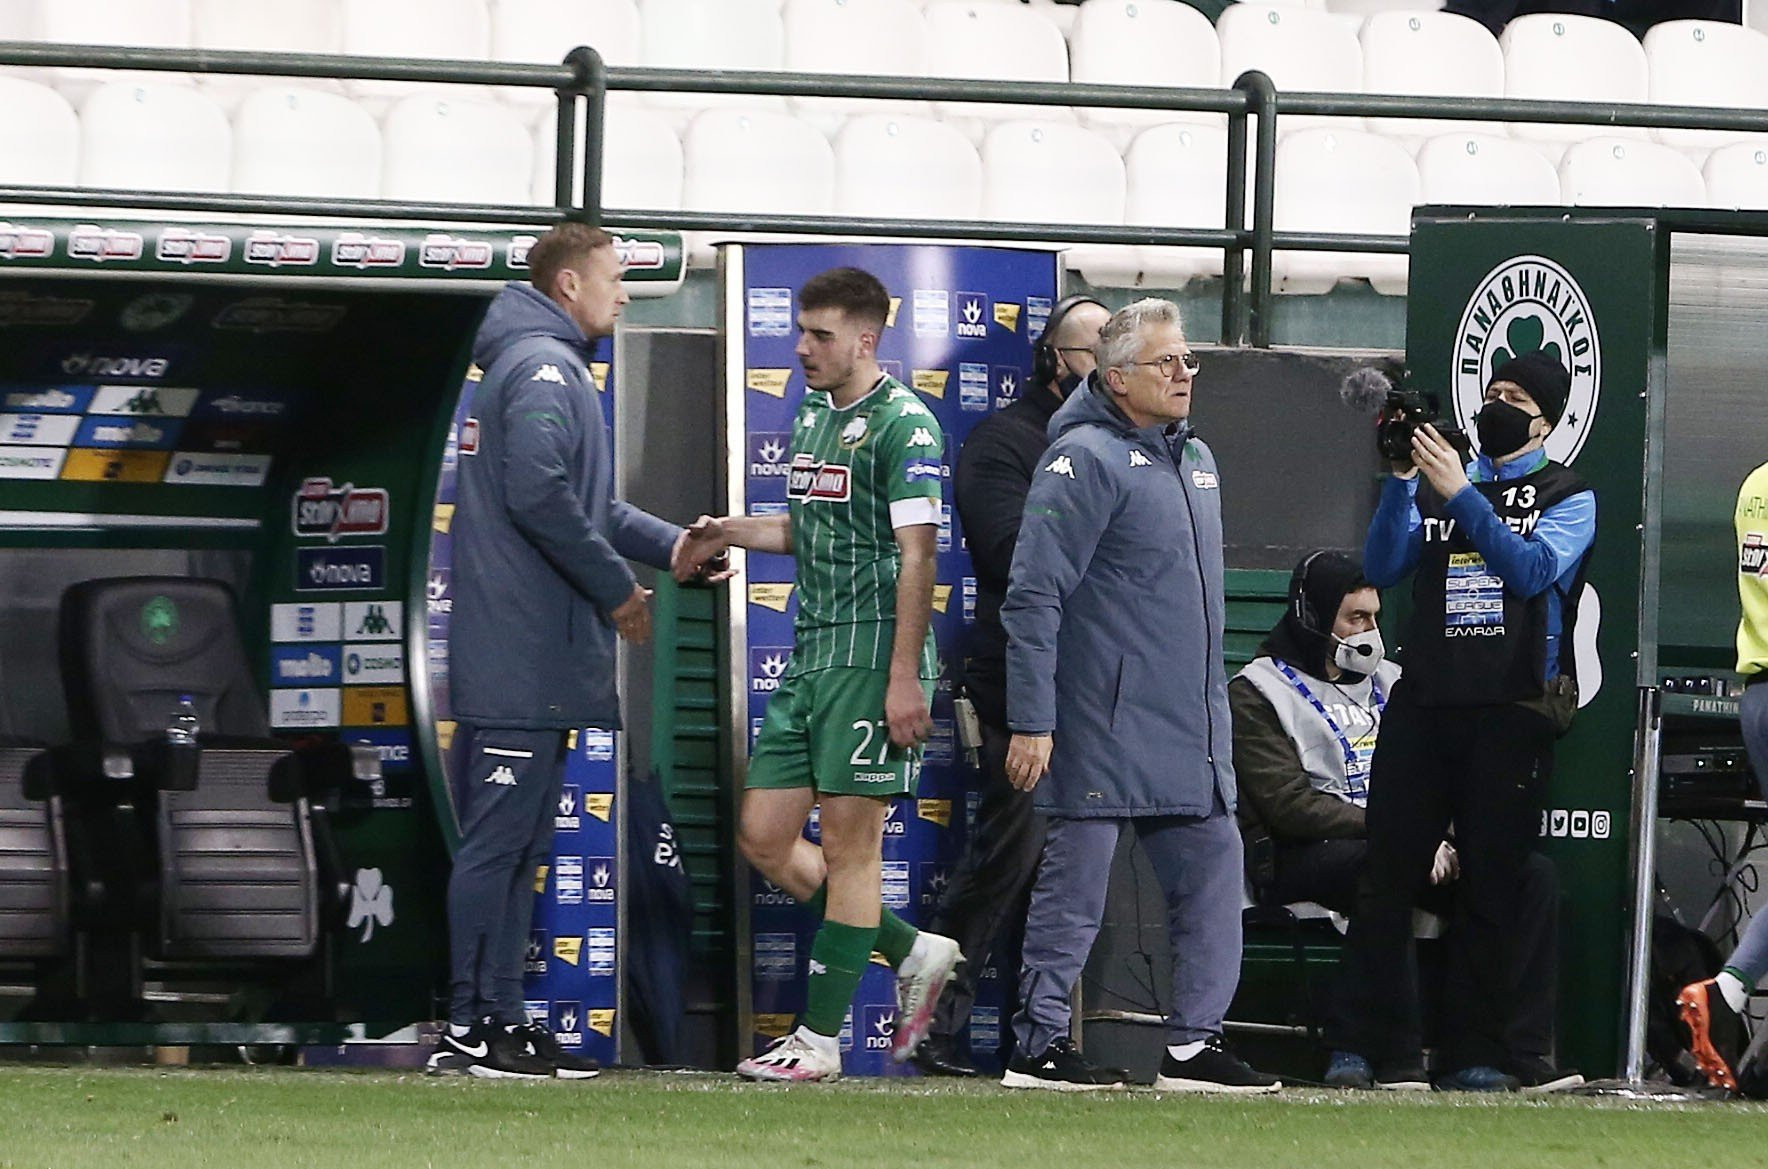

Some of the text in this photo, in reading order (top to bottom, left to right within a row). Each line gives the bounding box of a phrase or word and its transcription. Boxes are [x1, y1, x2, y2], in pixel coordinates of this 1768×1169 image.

[957, 323, 987, 337] nova
[90, 358, 169, 377] nova
[751, 463, 790, 476] nova
[1502, 485, 1537, 509] 13
[1424, 517, 1456, 542] TV
[327, 564, 372, 583] nova
[1447, 577, 1502, 589] SUPER
[1447, 601, 1502, 612] LEAGUE
[1692, 699, 1740, 713] PANATHIN
[755, 893, 795, 905] nova
